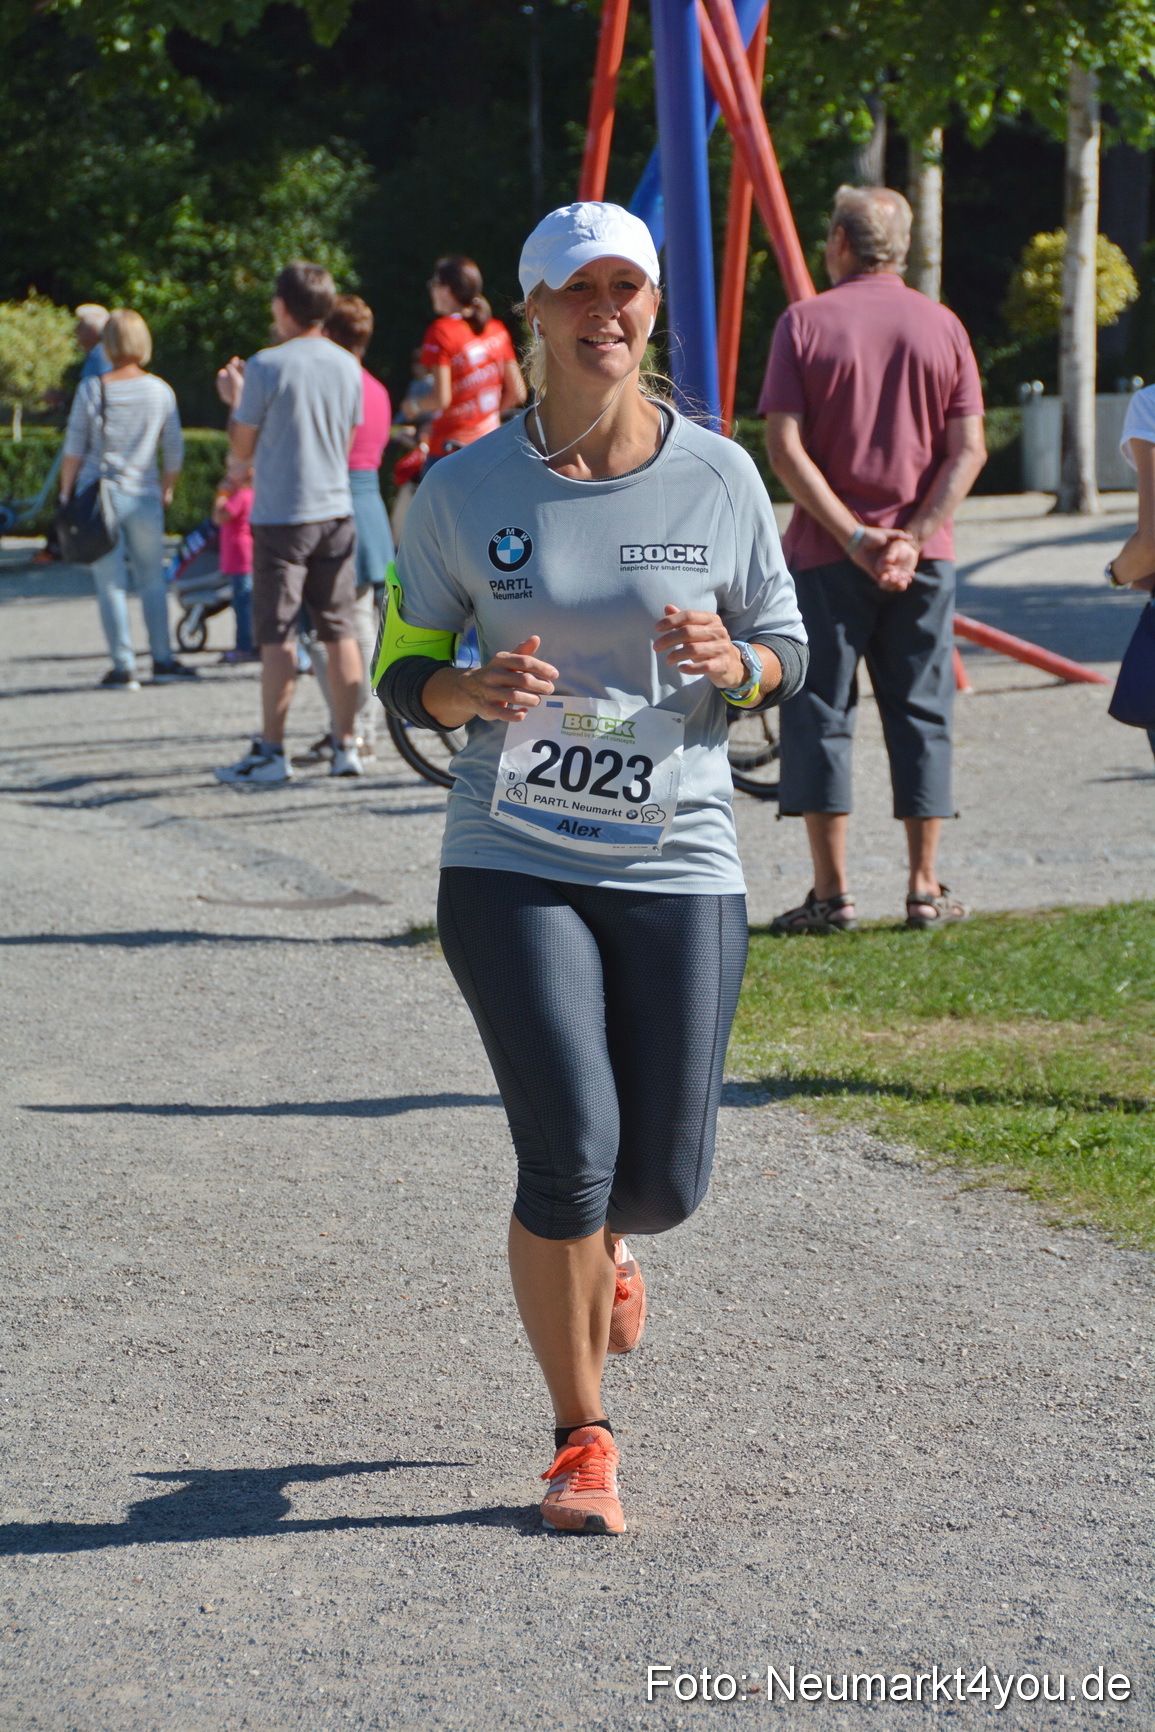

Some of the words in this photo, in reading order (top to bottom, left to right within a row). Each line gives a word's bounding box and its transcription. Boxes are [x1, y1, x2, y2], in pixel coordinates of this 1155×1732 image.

[493, 528, 530, 544] BMW
[620, 544, 709, 566] BOCK
[620, 564, 649, 573] inspired
[489, 578, 533, 591] PARTL
[492, 590, 533, 601] Neumarkt
[562, 713, 636, 738] BOCK
[560, 729, 584, 738] inspired
[609, 736, 636, 745] concepts
[508, 771, 516, 781] D
[525, 739, 654, 804] 2023
[533, 794, 569, 809] PARTL
[571, 801, 623, 817] Neumarkt
[556, 818, 602, 838] Alex
